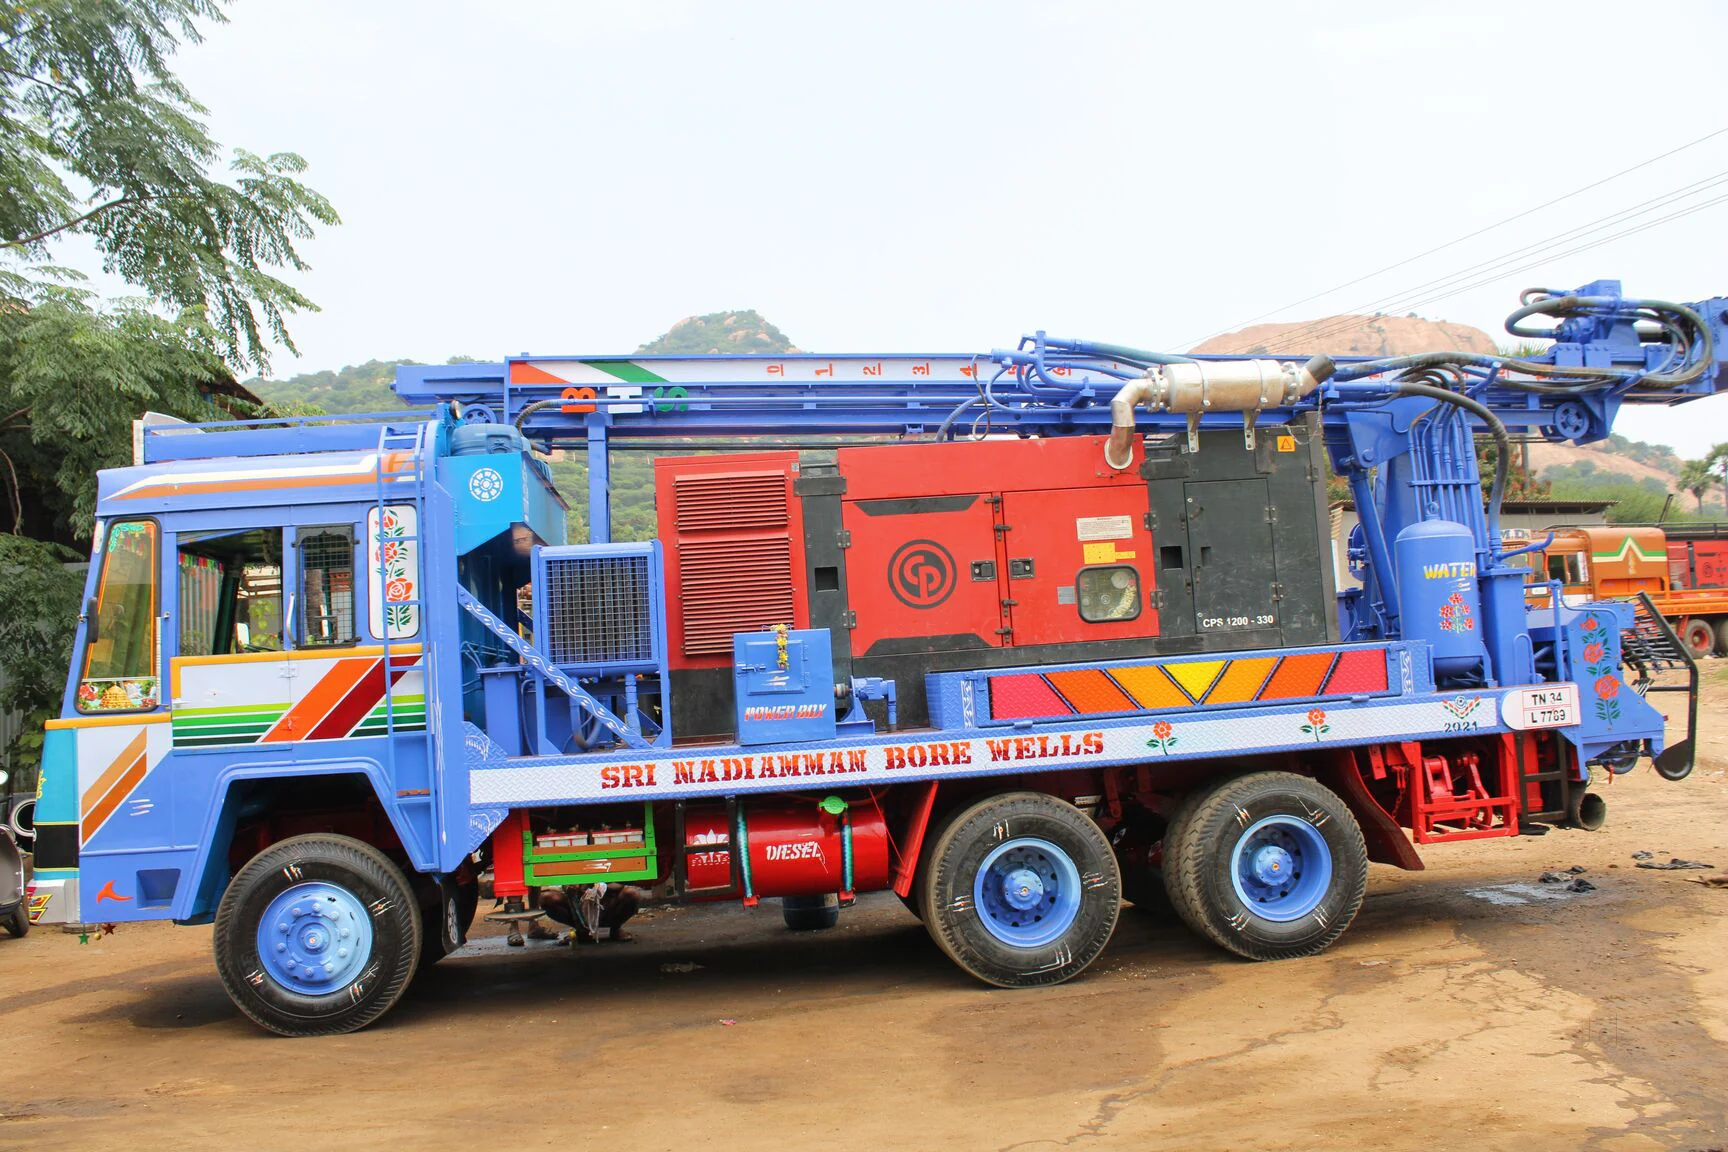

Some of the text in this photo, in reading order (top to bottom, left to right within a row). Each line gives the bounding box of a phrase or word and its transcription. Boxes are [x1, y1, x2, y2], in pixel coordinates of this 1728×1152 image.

[815, 363, 833, 376] 1
[863, 363, 882, 376] 2
[912, 363, 930, 376] 3
[1203, 618, 1223, 627] CPS
[1226, 617, 1248, 626] 1200
[1256, 615, 1274, 624] 330
[1532, 692, 1562, 705] TN 34
[744, 703, 827, 720] POWER BOX
[1531, 712, 1538, 723] L
[1443, 721, 1478, 733] 2021
[600, 732, 1104, 789] SRI NADIAMMAN BORE WELLS
[766, 841, 821, 861] DIESEL
